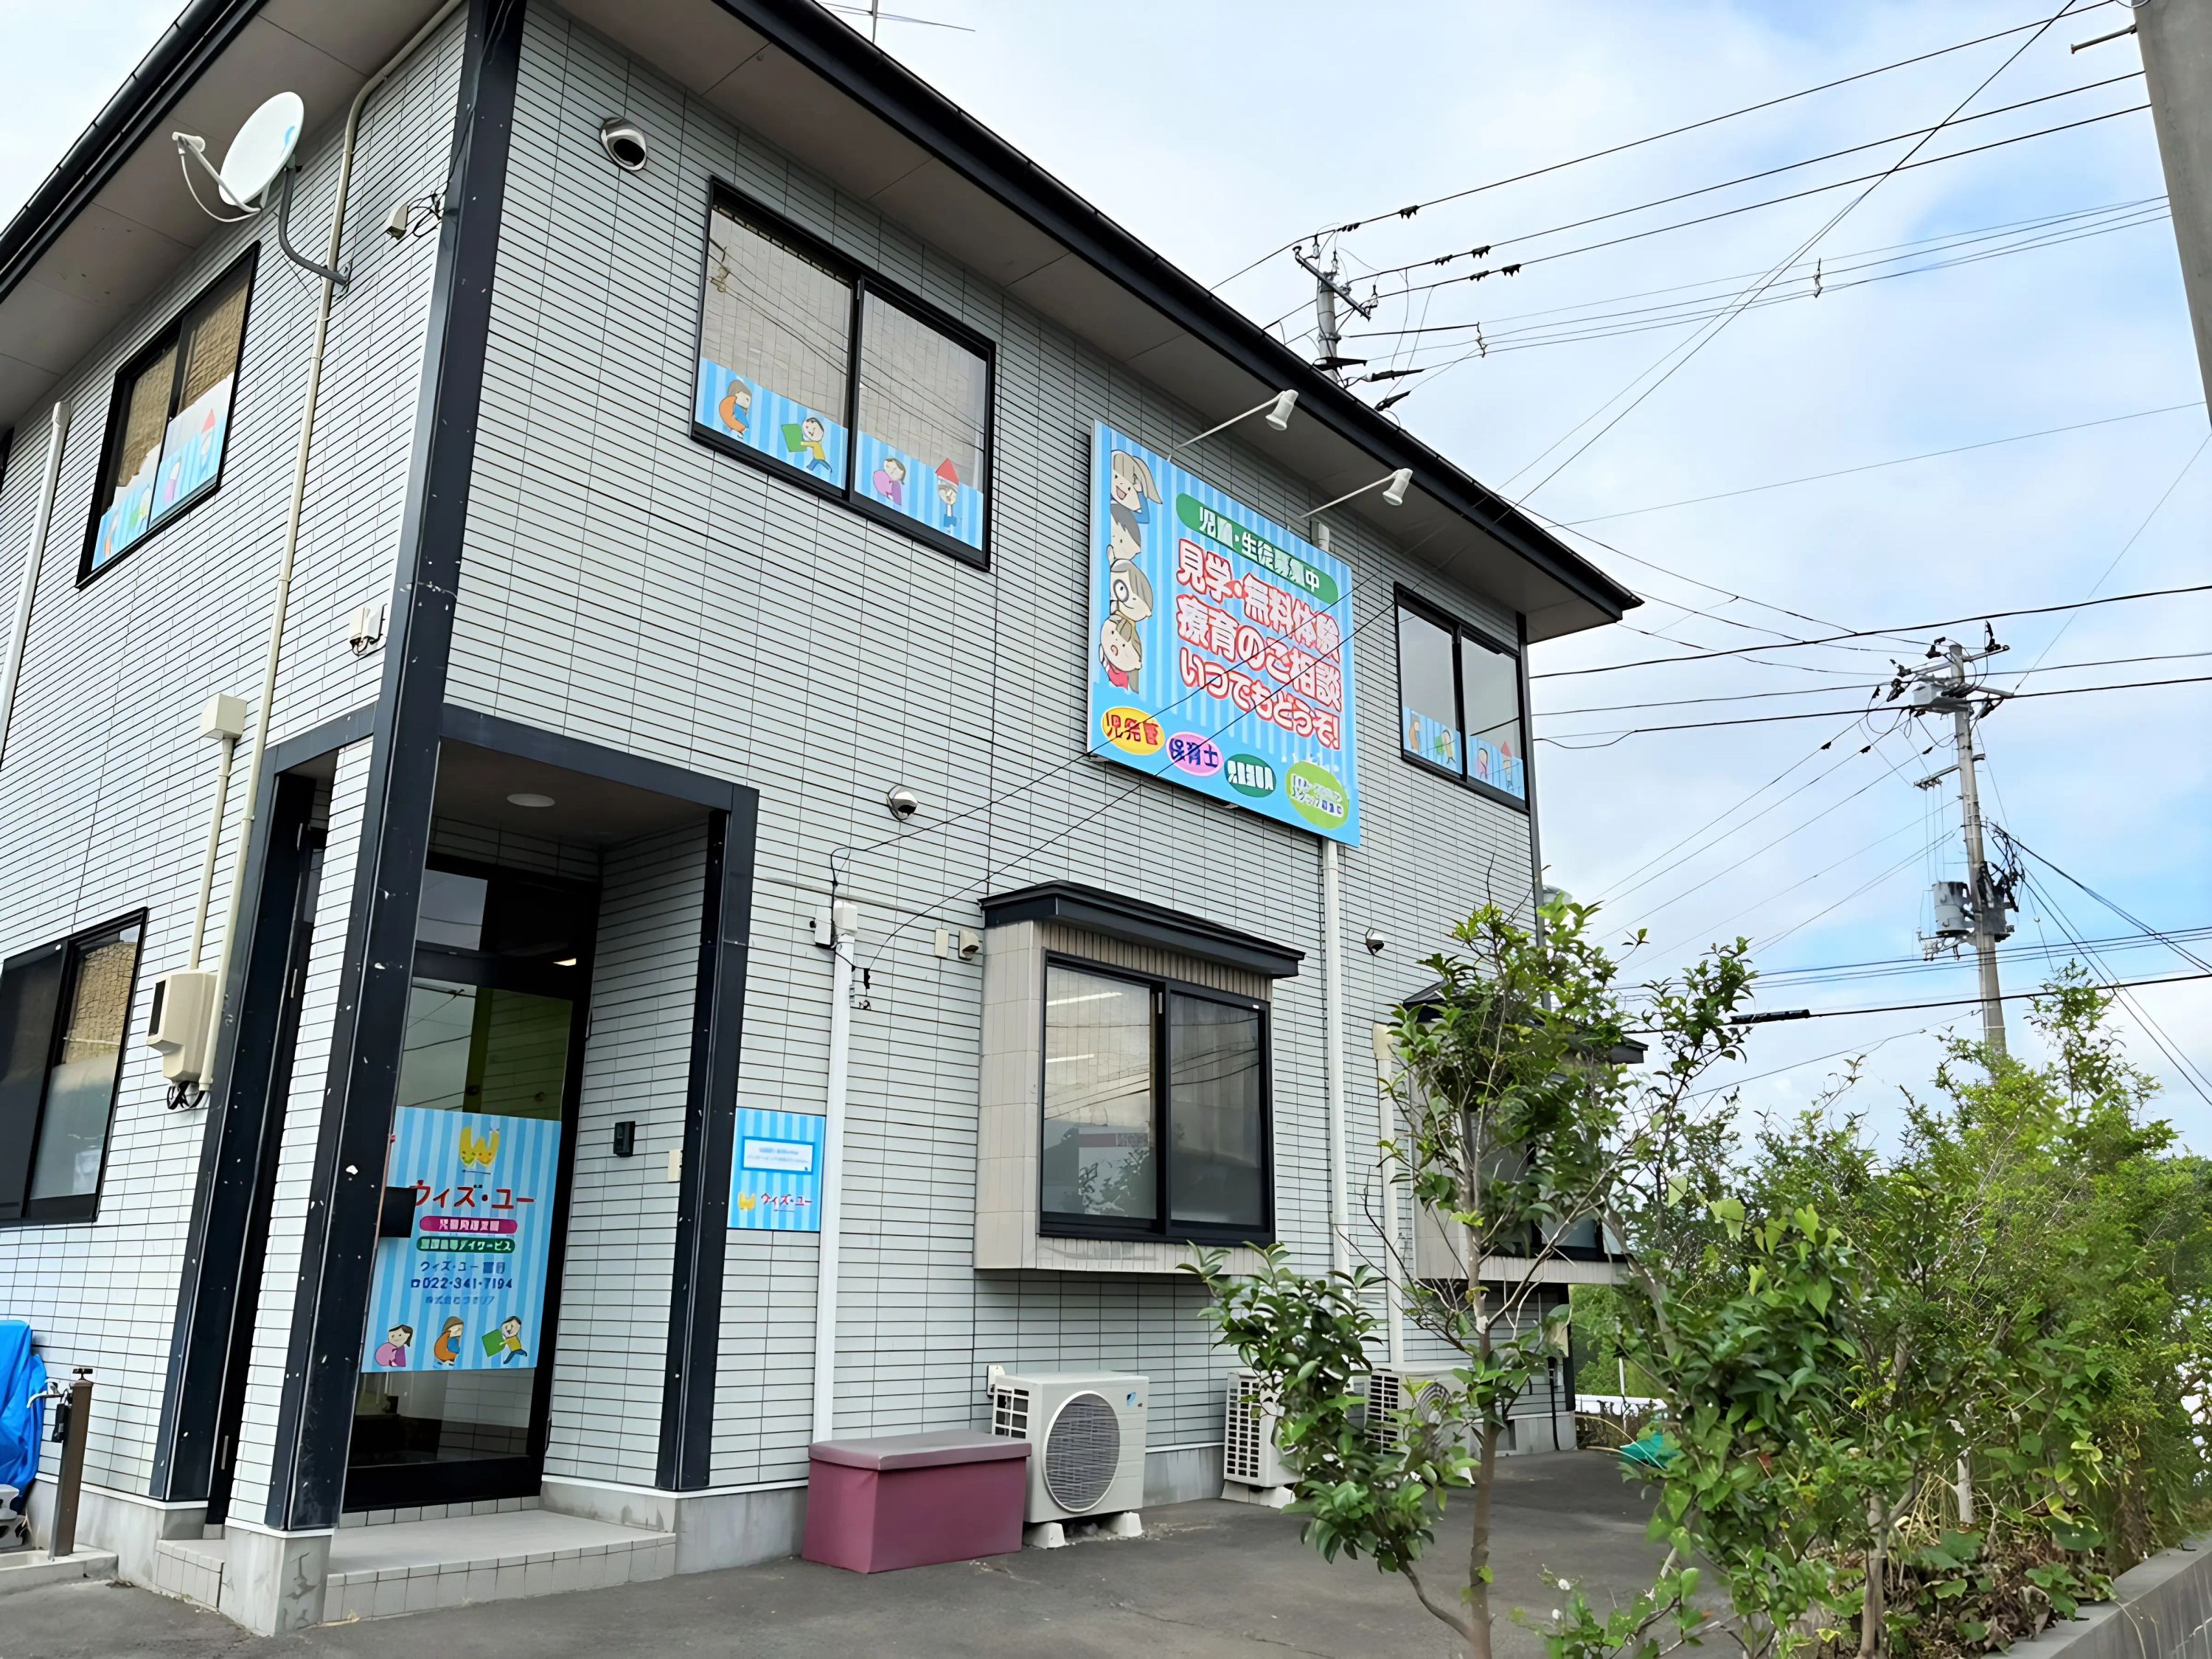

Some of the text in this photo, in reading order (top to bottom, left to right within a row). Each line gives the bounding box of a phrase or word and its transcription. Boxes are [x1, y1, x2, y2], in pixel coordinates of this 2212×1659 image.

[409, 1180, 535, 1209] ウィズ・ユー
